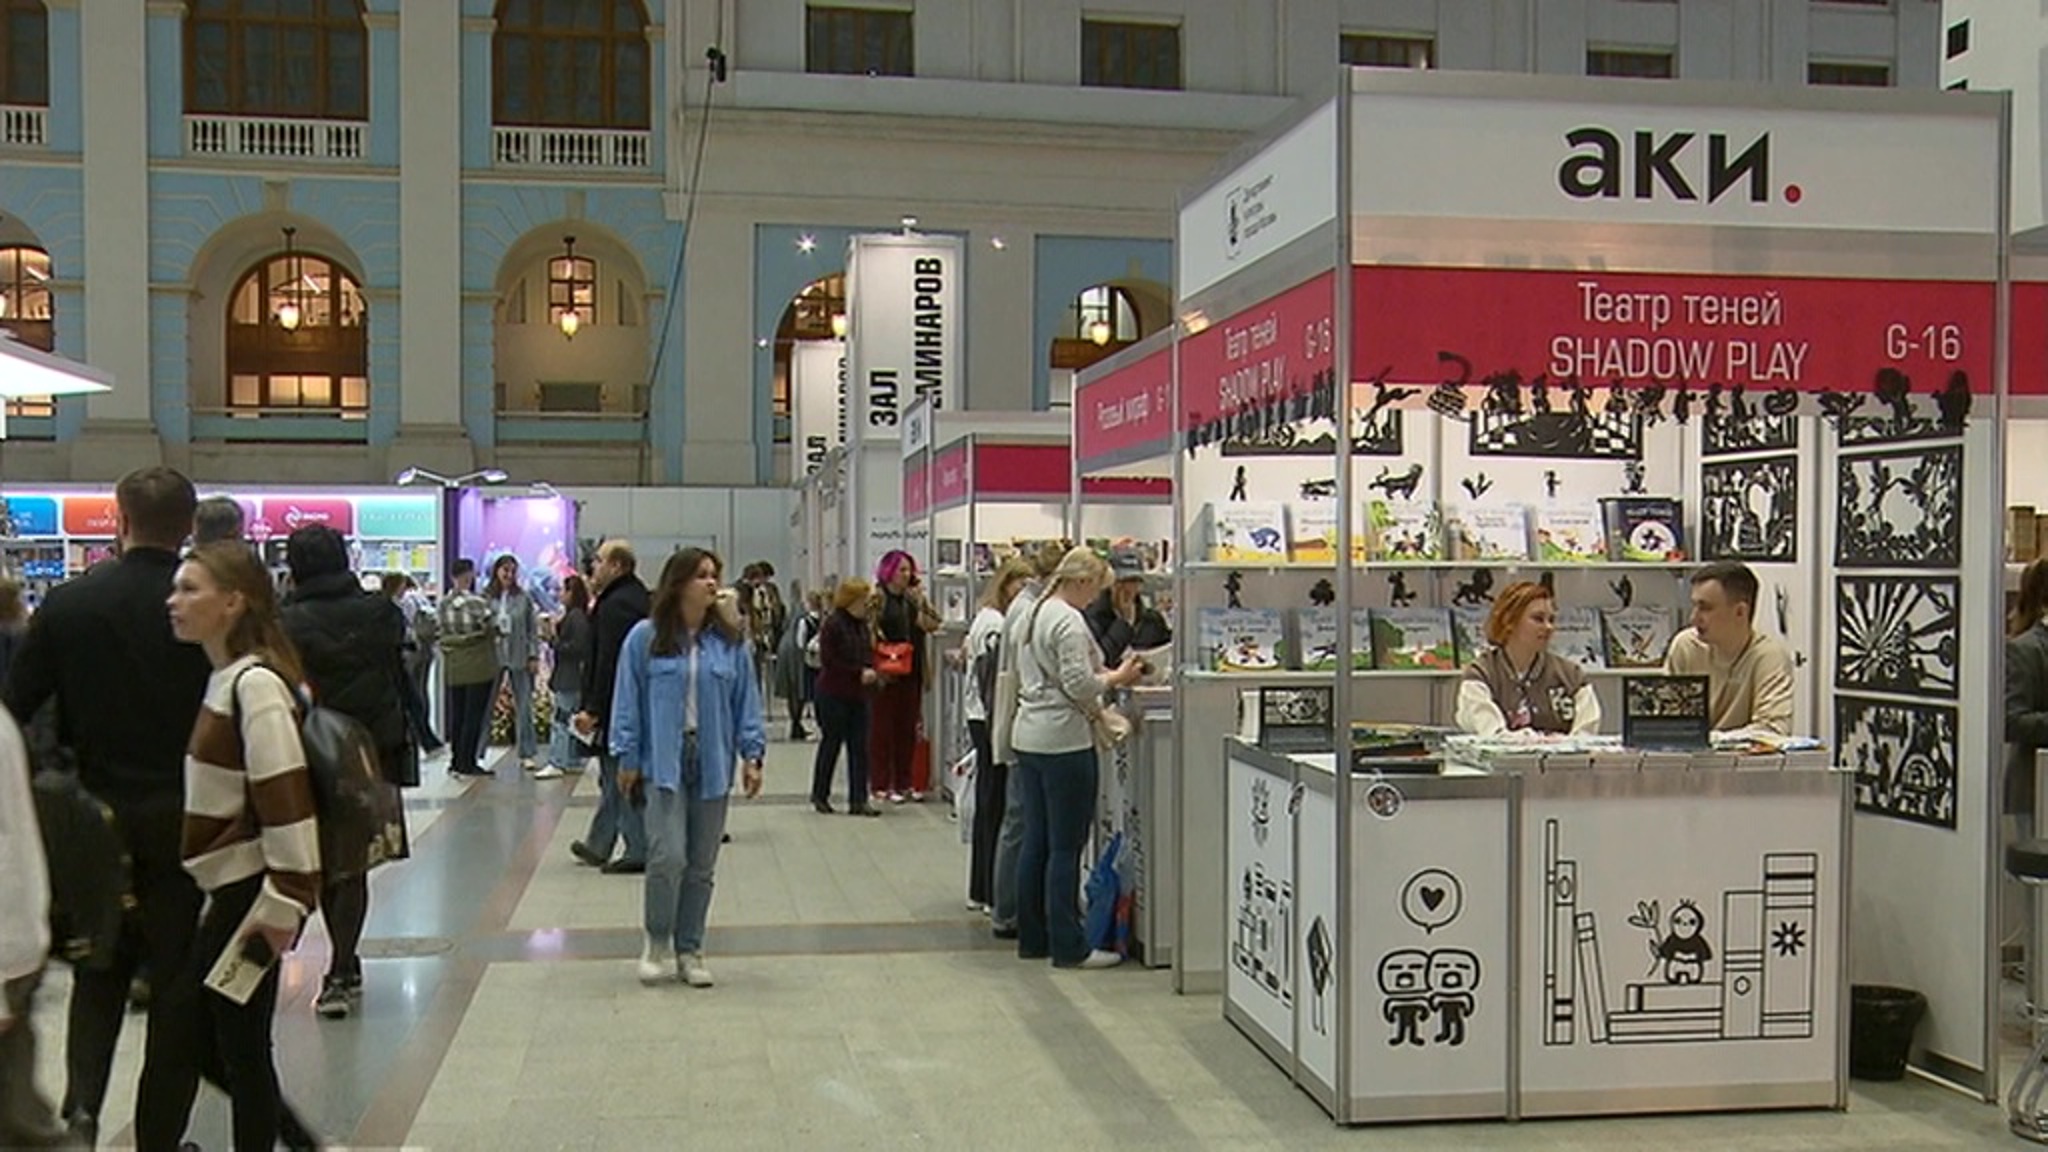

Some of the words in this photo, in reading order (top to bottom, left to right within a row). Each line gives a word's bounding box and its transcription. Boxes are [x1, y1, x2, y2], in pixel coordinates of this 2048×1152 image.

[1578, 282, 1671, 332] Театр
[1683, 291, 1781, 325] теней
[1551, 337, 1714, 379] SHADOW
[1727, 341, 1808, 381] PLAY
[1887, 323, 1960, 360] G-16
[870, 371, 897, 426] ЗАЛ
